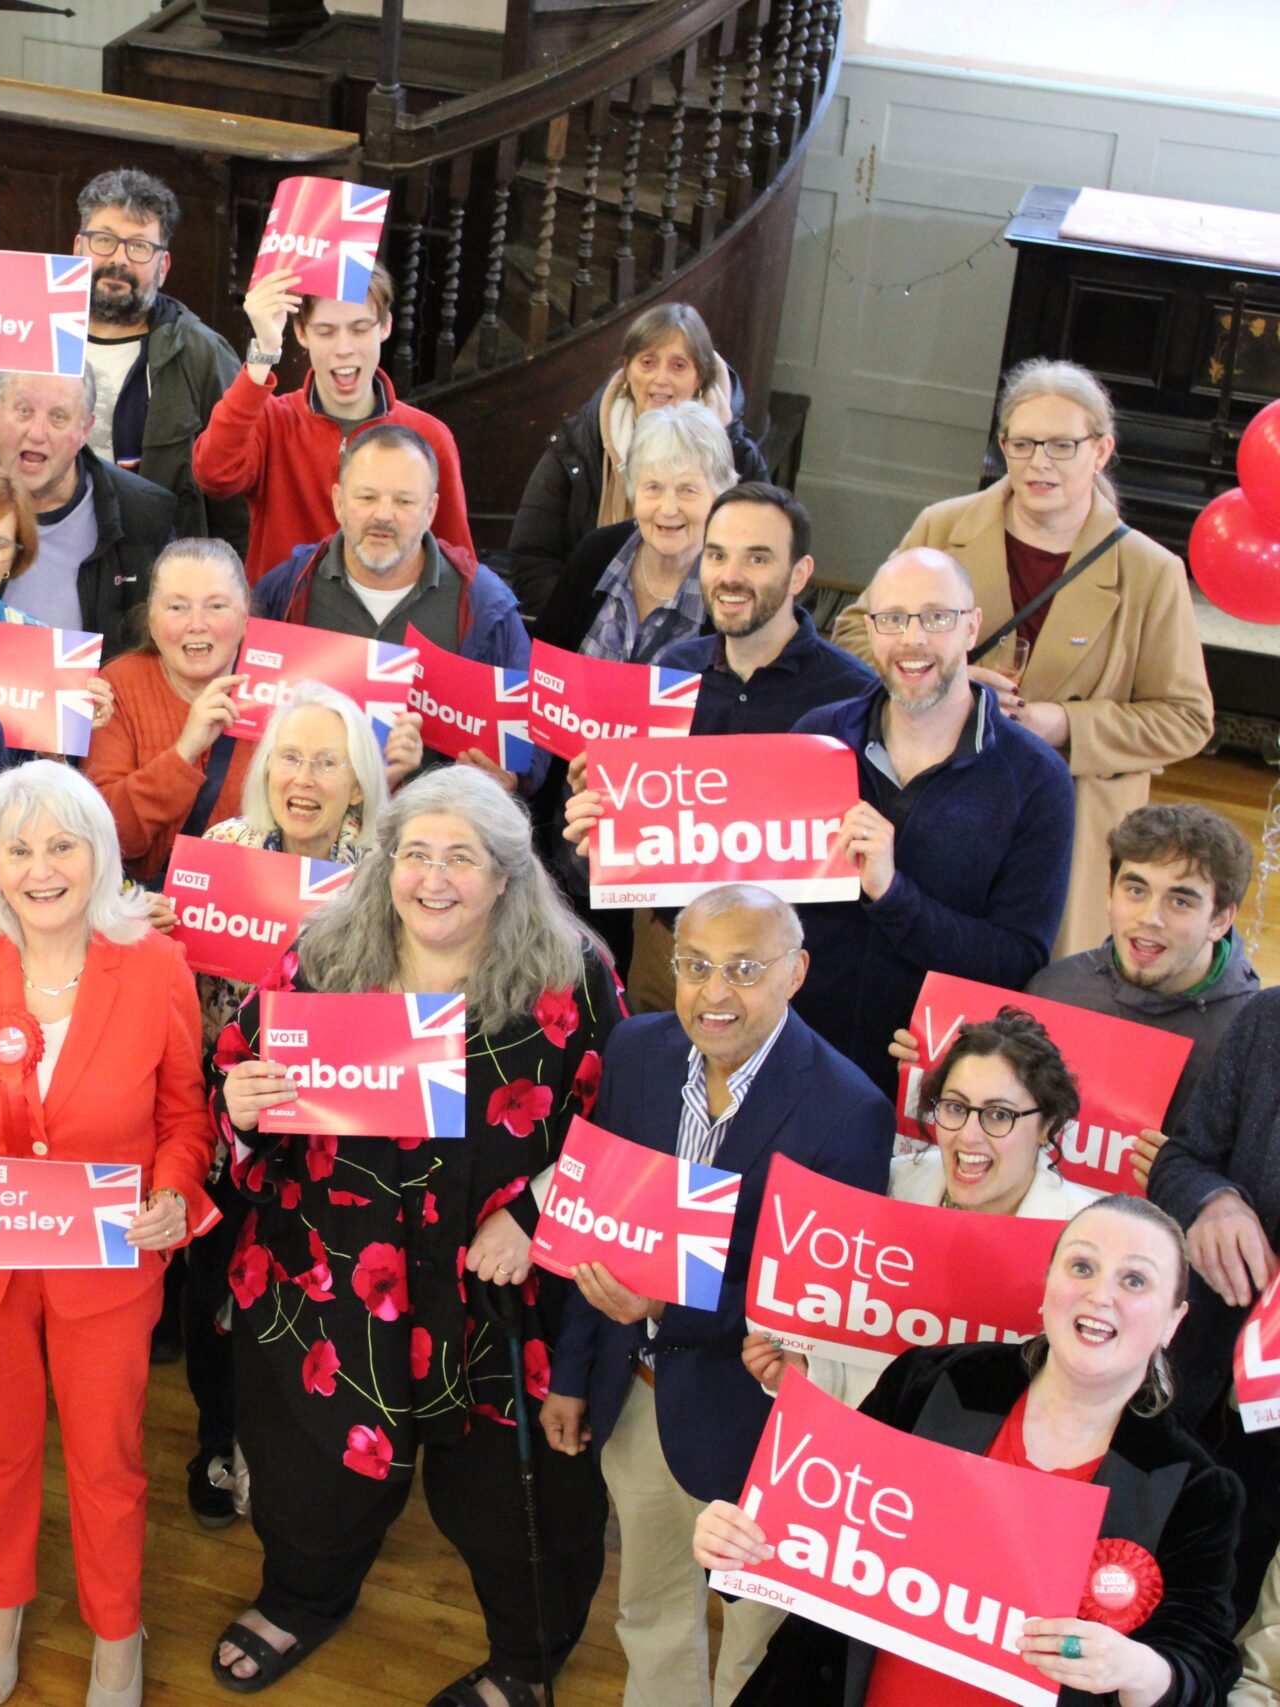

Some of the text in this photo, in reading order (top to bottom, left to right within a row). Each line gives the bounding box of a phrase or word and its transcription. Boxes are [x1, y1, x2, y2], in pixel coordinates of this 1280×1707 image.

[258, 229, 330, 259] abour
[236, 673, 295, 707] Lab
[536, 672, 562, 690] VOTE
[406, 687, 487, 737] abour
[531, 690, 638, 740] Labour
[596, 762, 729, 811] Vote
[598, 810, 841, 867] Labour
[176, 871, 207, 887] VOTE
[612, 892, 658, 904] Labour
[270, 1032, 305, 1044] VOTE
[267, 1058, 405, 1090] abour
[562, 1158, 583, 1178] VOTE
[544, 1184, 664, 1254] Labour
[774, 1194, 914, 1287] Vote
[771, 1336, 816, 1352] bour
[769, 1411, 914, 1539] Vote
[738, 1579, 797, 1606] Labour
